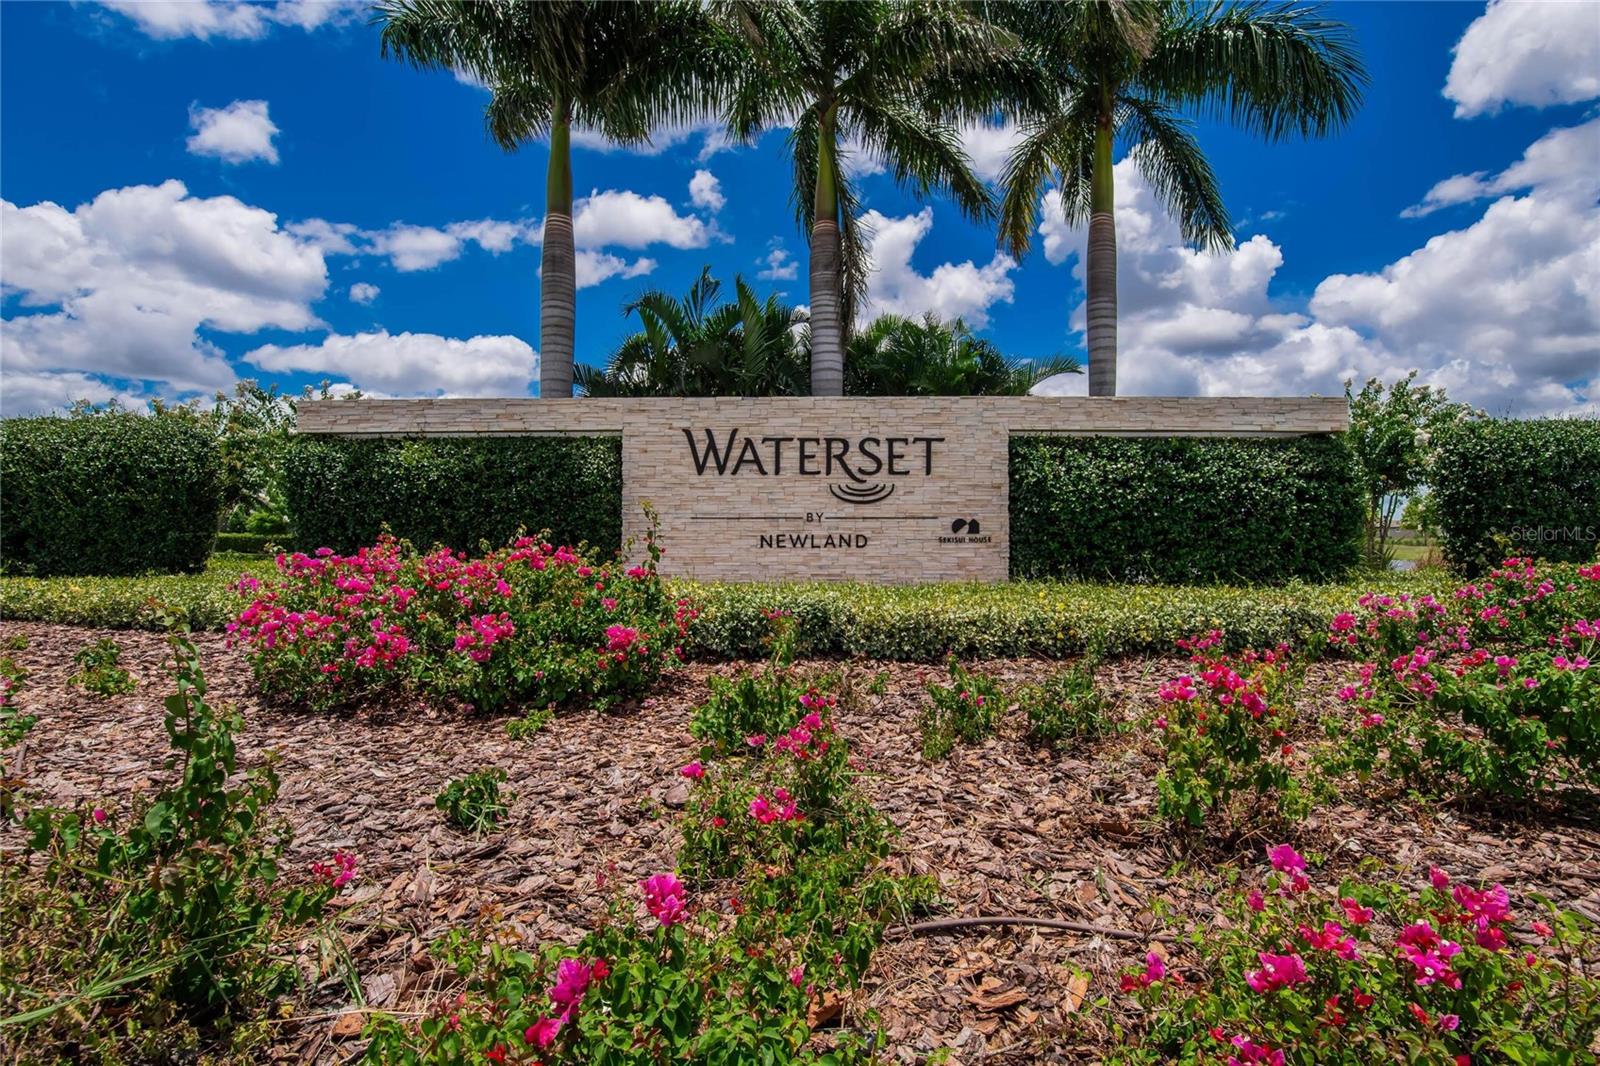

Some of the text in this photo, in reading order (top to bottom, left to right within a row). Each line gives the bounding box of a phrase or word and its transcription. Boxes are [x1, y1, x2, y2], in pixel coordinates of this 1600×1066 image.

[682, 428, 945, 483] WATERSET
[806, 512, 824, 523] BY
[760, 534, 868, 549] NEWLAND
[938, 536, 992, 544] SEKISUI HOUSE
